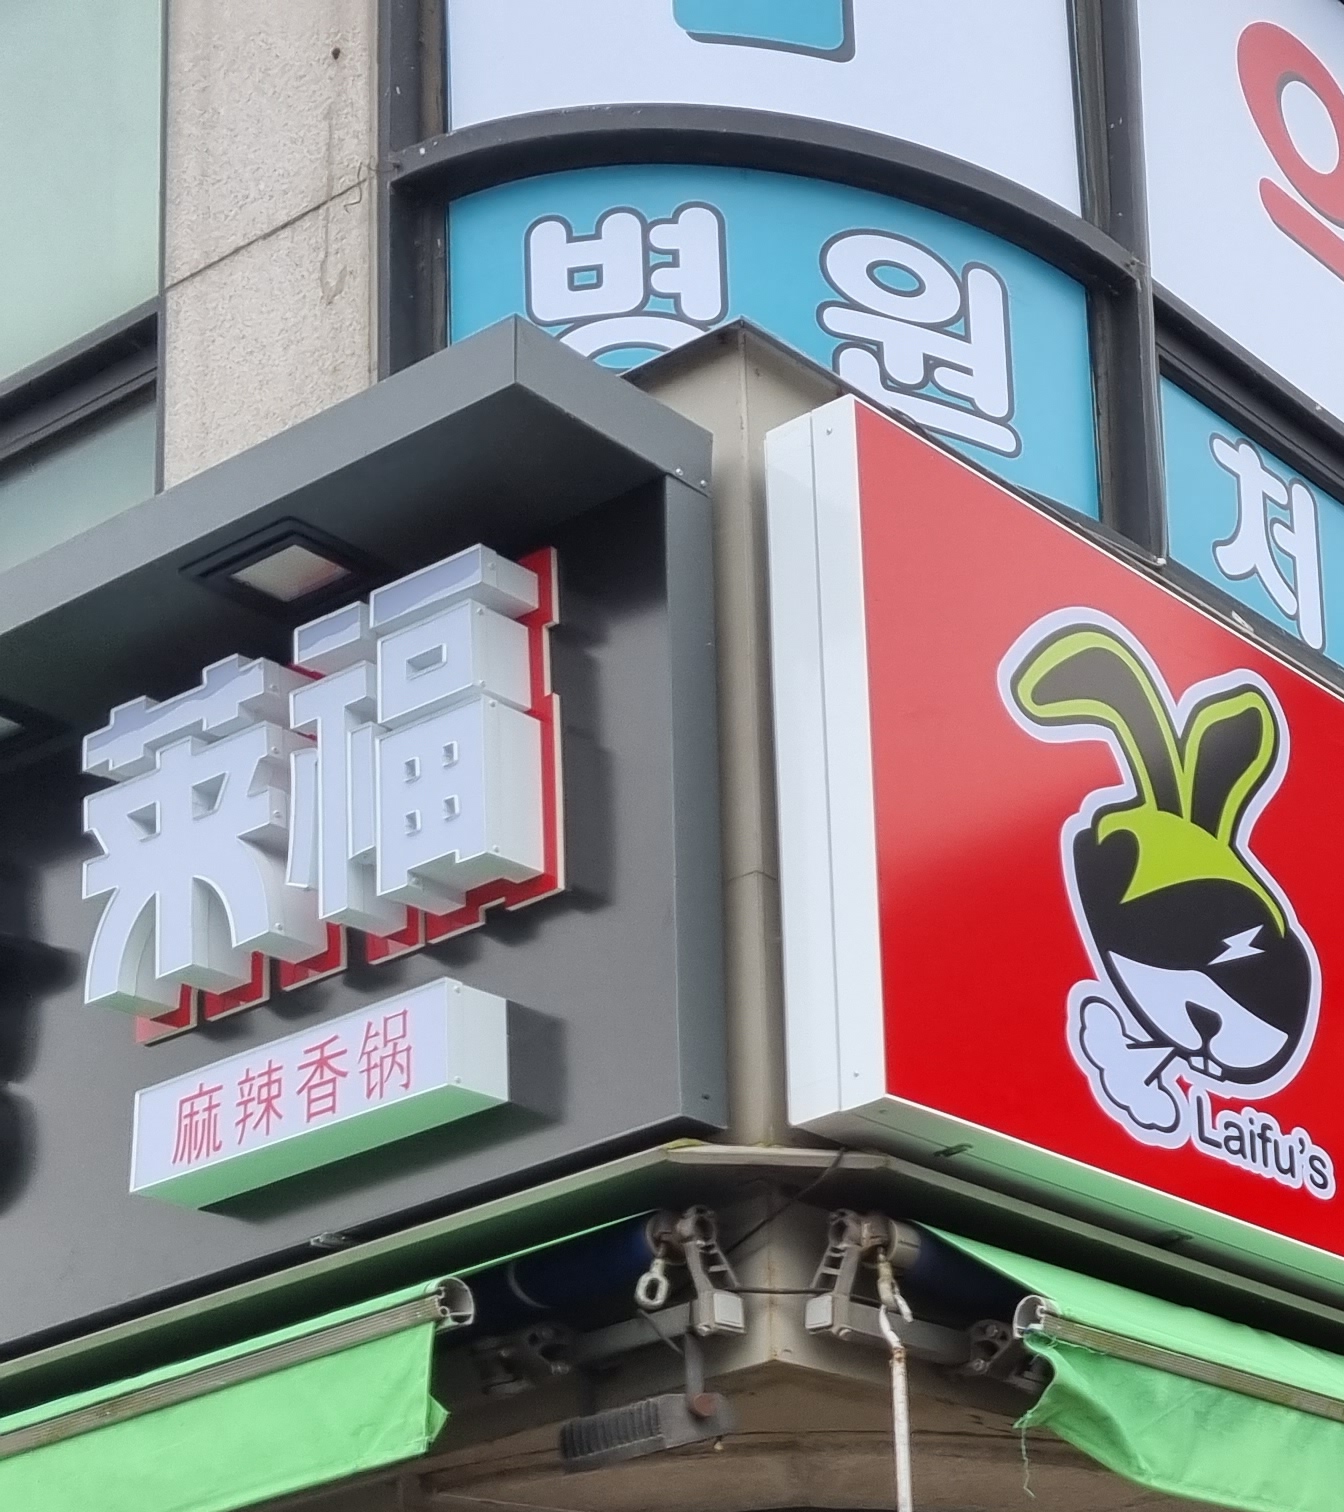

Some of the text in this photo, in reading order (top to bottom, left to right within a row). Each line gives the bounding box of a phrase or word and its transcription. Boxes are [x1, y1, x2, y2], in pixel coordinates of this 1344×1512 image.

[525, 201, 1022, 457] 병원
[172, 1010, 413, 1167] 麻辣香锅
[1195, 1094, 1329, 1190] Laifu's
